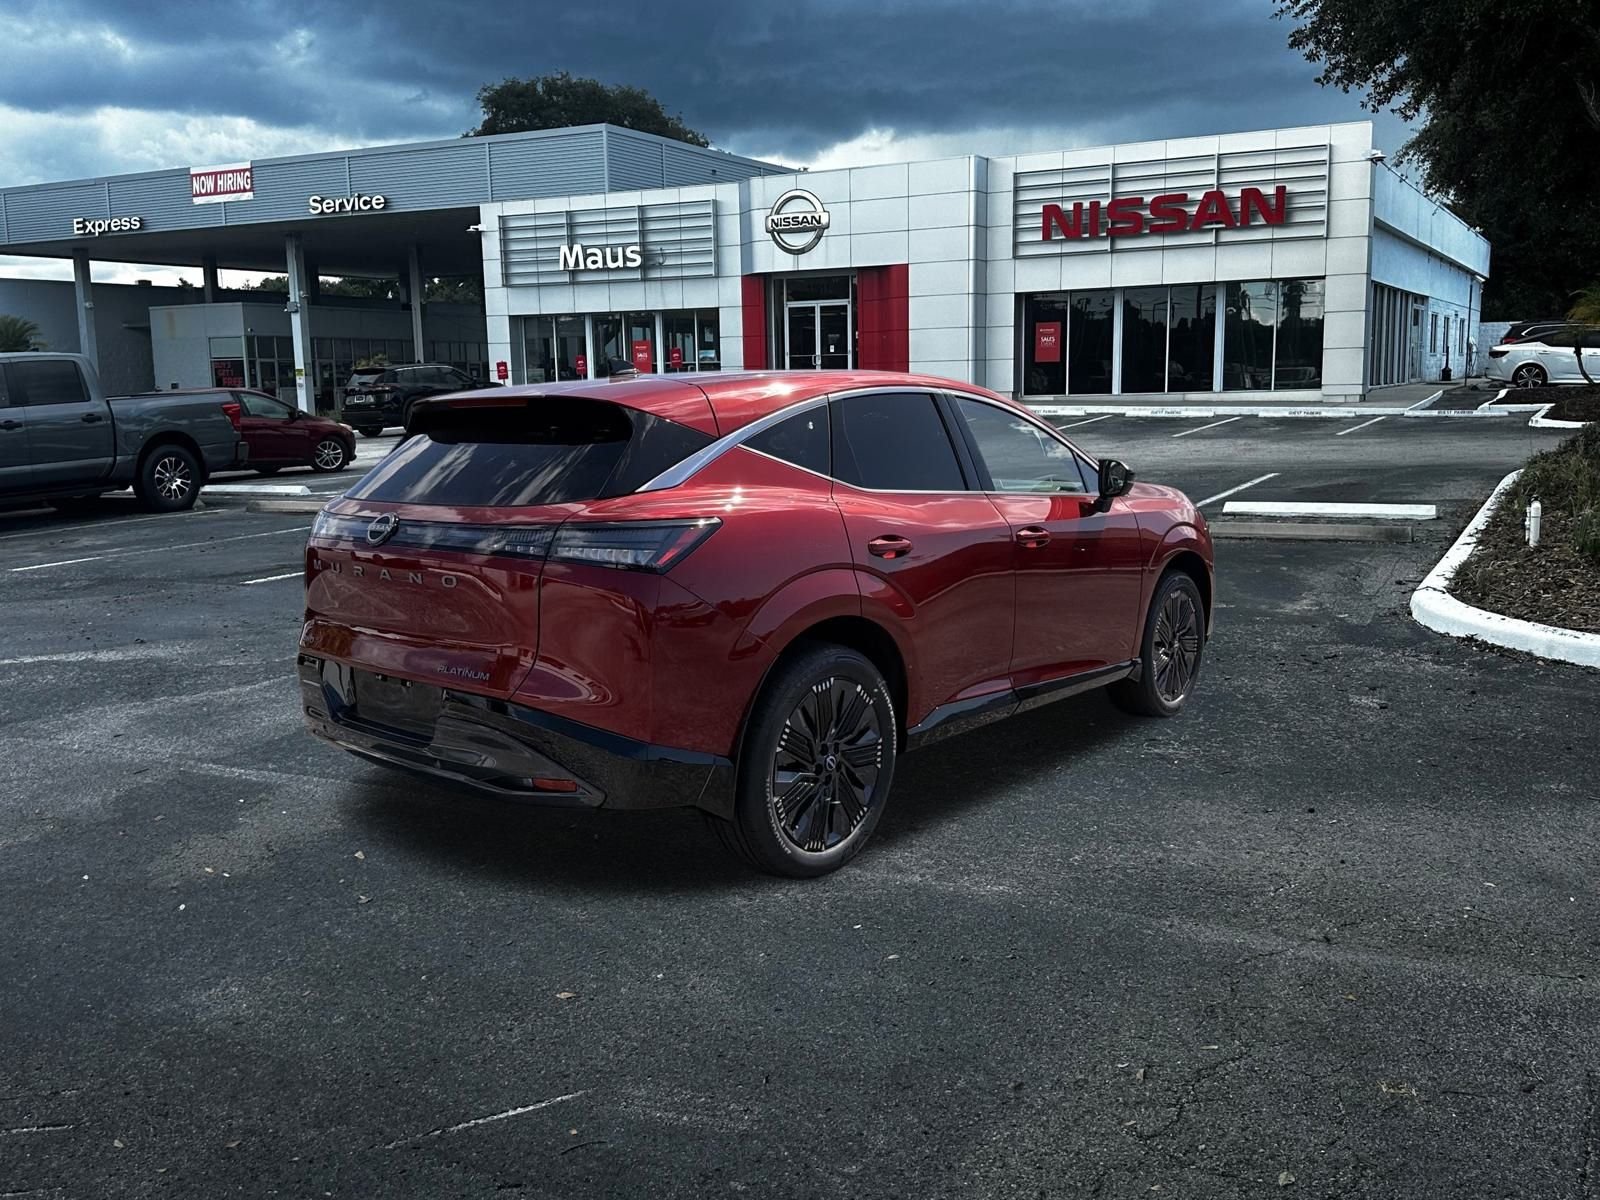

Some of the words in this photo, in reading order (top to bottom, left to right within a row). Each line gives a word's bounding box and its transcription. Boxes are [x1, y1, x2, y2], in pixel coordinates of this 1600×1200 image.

[193, 174, 215, 194] NOW
[217, 171, 251, 191] HIRING
[309, 193, 385, 214] Service
[1042, 185, 1287, 241] NISSAN
[73, 216, 141, 236] Express
[770, 215, 822, 228] NISSAN
[559, 244, 642, 271] Maus
[313, 559, 458, 589] MURANO
[438, 664, 490, 680] PLATINUM
